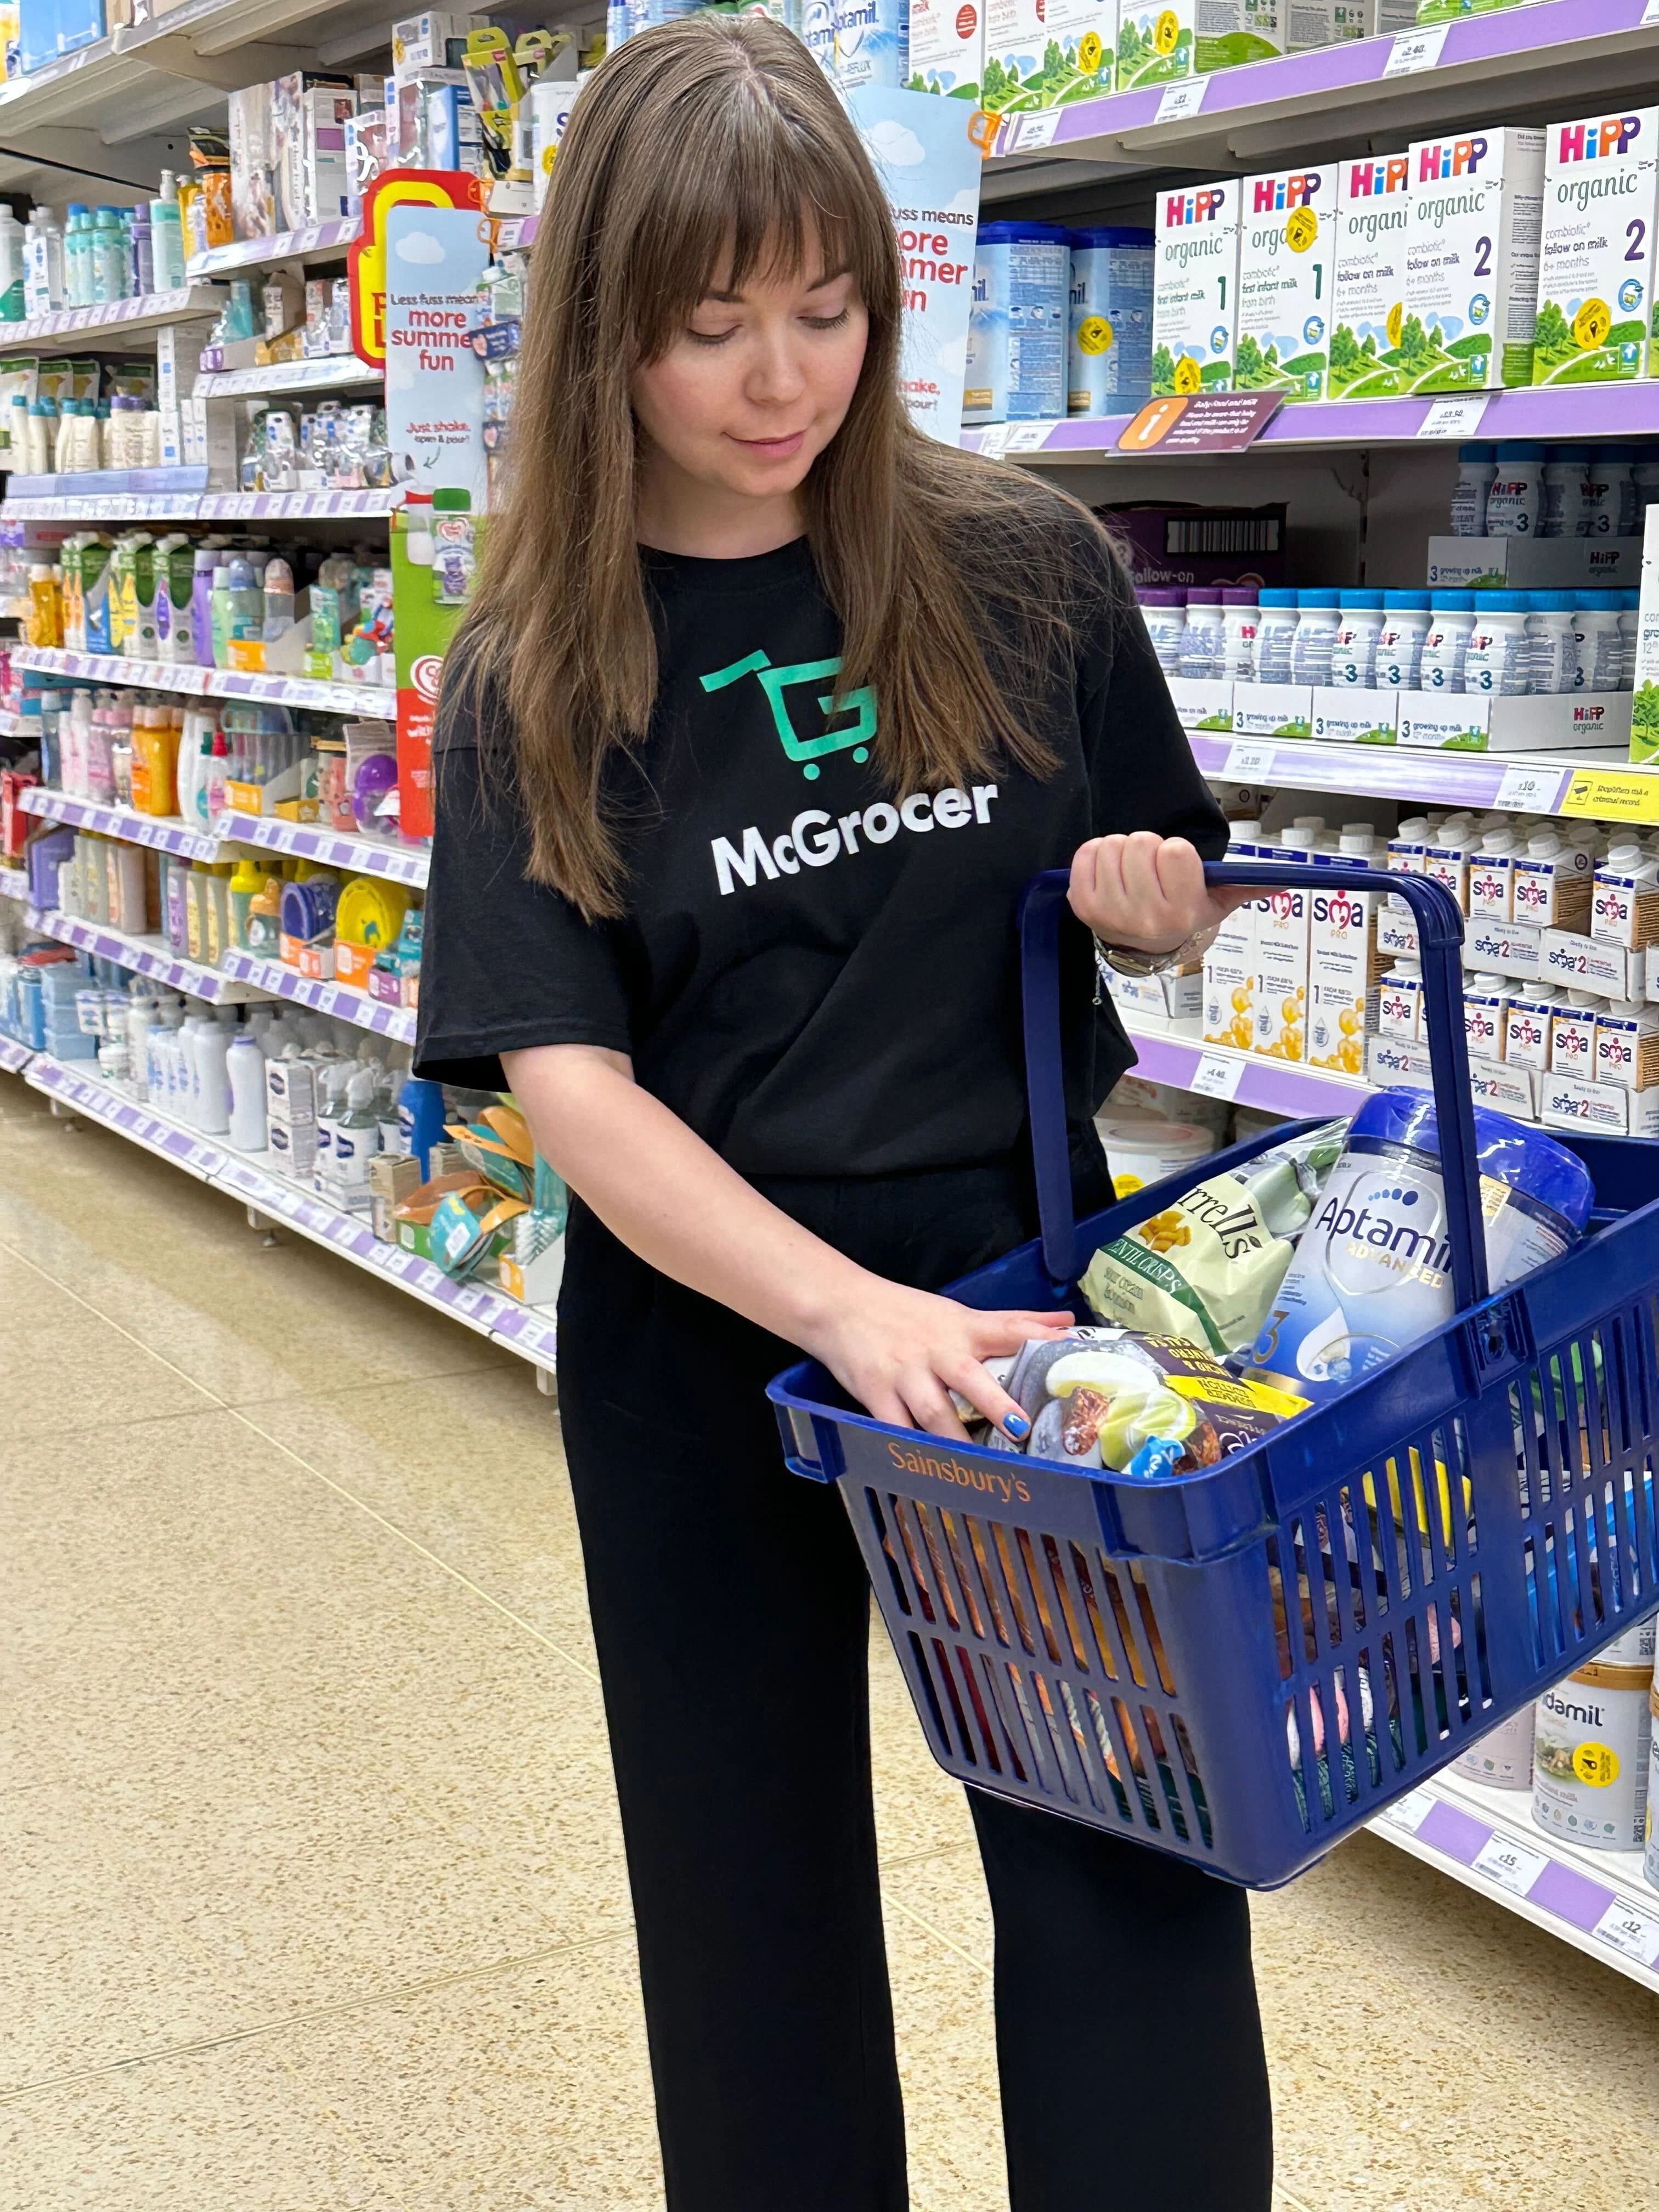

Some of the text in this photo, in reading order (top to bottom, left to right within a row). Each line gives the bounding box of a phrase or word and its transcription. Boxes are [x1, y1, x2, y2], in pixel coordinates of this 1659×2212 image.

[1560, 116, 1641, 163] HiPP
[1419, 138, 1488, 182] HiPP
[1254, 173, 1321, 213] HiPP
[1558, 168, 1638, 211] organic
[894, 206, 974, 226] uss means
[1166, 188, 1224, 227] HiPP
[1418, 188, 1485, 228] organic
[1349, 204, 1408, 242] organi
[899, 229, 948, 255] ore
[1165, 232, 1223, 268] organic
[1573, 242, 1585, 252] on
[1588, 236, 1608, 250] milk
[1624, 218, 1645, 262] 2
[1474, 236, 1492, 276] 2
[1556, 255, 1589, 270] months
[1313, 264, 1322, 300] 1
[1217, 276, 1226, 311] 1
[408, 309, 467, 328] more
[391, 330, 472, 348] summe
[419, 349, 454, 371] fun
[1492, 482, 1528, 496] HiPP
[1516, 512, 1529, 532] 3
[1597, 514, 1610, 533] 3
[1589, 551, 1620, 565] HiPP
[1130, 566, 1195, 584] ollow-on
[1430, 566, 1438, 582] 3
[1345, 664, 1358, 682] 3
[1388, 664, 1401, 685] 3
[1431, 668, 1444, 687] 3
[1480, 670, 1493, 690] 3
[1237, 712, 1244, 728] 3
[1573, 706, 1605, 721] HiPP
[1316, 718, 1324, 735] 3
[1402, 720, 1410, 738] 3
[1573, 721, 1604, 735] organic
[711, 783, 998, 895] McGrocer
[1473, 874, 1504, 900] sma
[1516, 880, 1547, 905] sma
[1313, 890, 1363, 930] sma
[1595, 894, 1628, 920] sma
[1500, 940, 1510, 957] 2
[1577, 956, 1587, 974] 2
[1383, 996, 1412, 1019] sma
[1510, 1019, 1542, 1044] sma
[1556, 1028, 1588, 1053] sma
[1599, 1037, 1632, 1063] sma
[1400, 1054, 1409, 1071] 2
[1488, 1080, 1498, 1097] 2
[1580, 1099, 1589, 1117] 2
[1108, 1238, 1182, 1294] ENTIL CRISPS
[1345, 1241, 1446, 1289] ADVANCED
[1252, 1310, 1291, 1364] 3
[888, 1441, 1031, 1503] Sainsbury's
[1544, 1691, 1604, 1727] damil
[1498, 1853, 1518, 1866] £15
